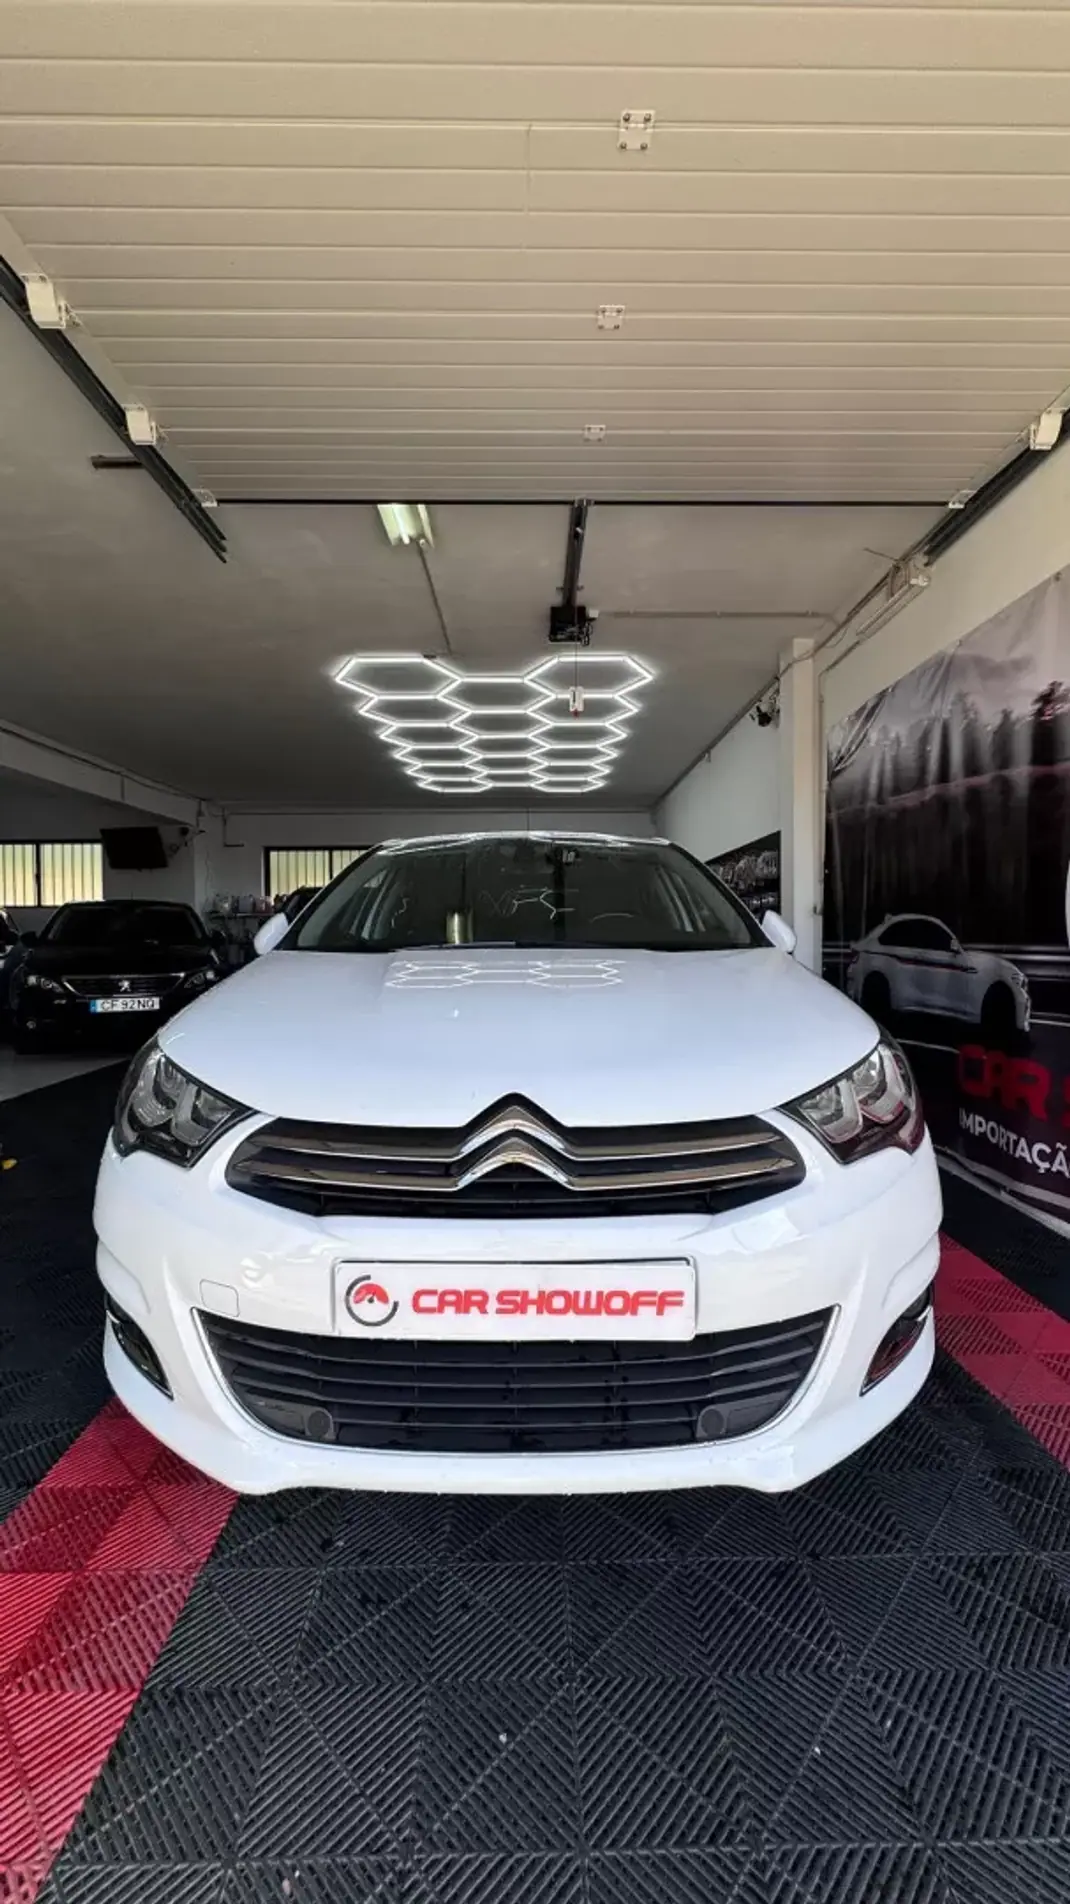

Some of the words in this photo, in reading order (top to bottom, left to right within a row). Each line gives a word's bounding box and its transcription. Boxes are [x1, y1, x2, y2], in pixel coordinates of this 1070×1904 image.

[958, 1044, 1051, 1122] CAR
[959, 1107, 1070, 1179] IMPORTAÇÃ
[412, 1288, 489, 1315] CAR
[495, 1288, 685, 1316] SHOWOFF
